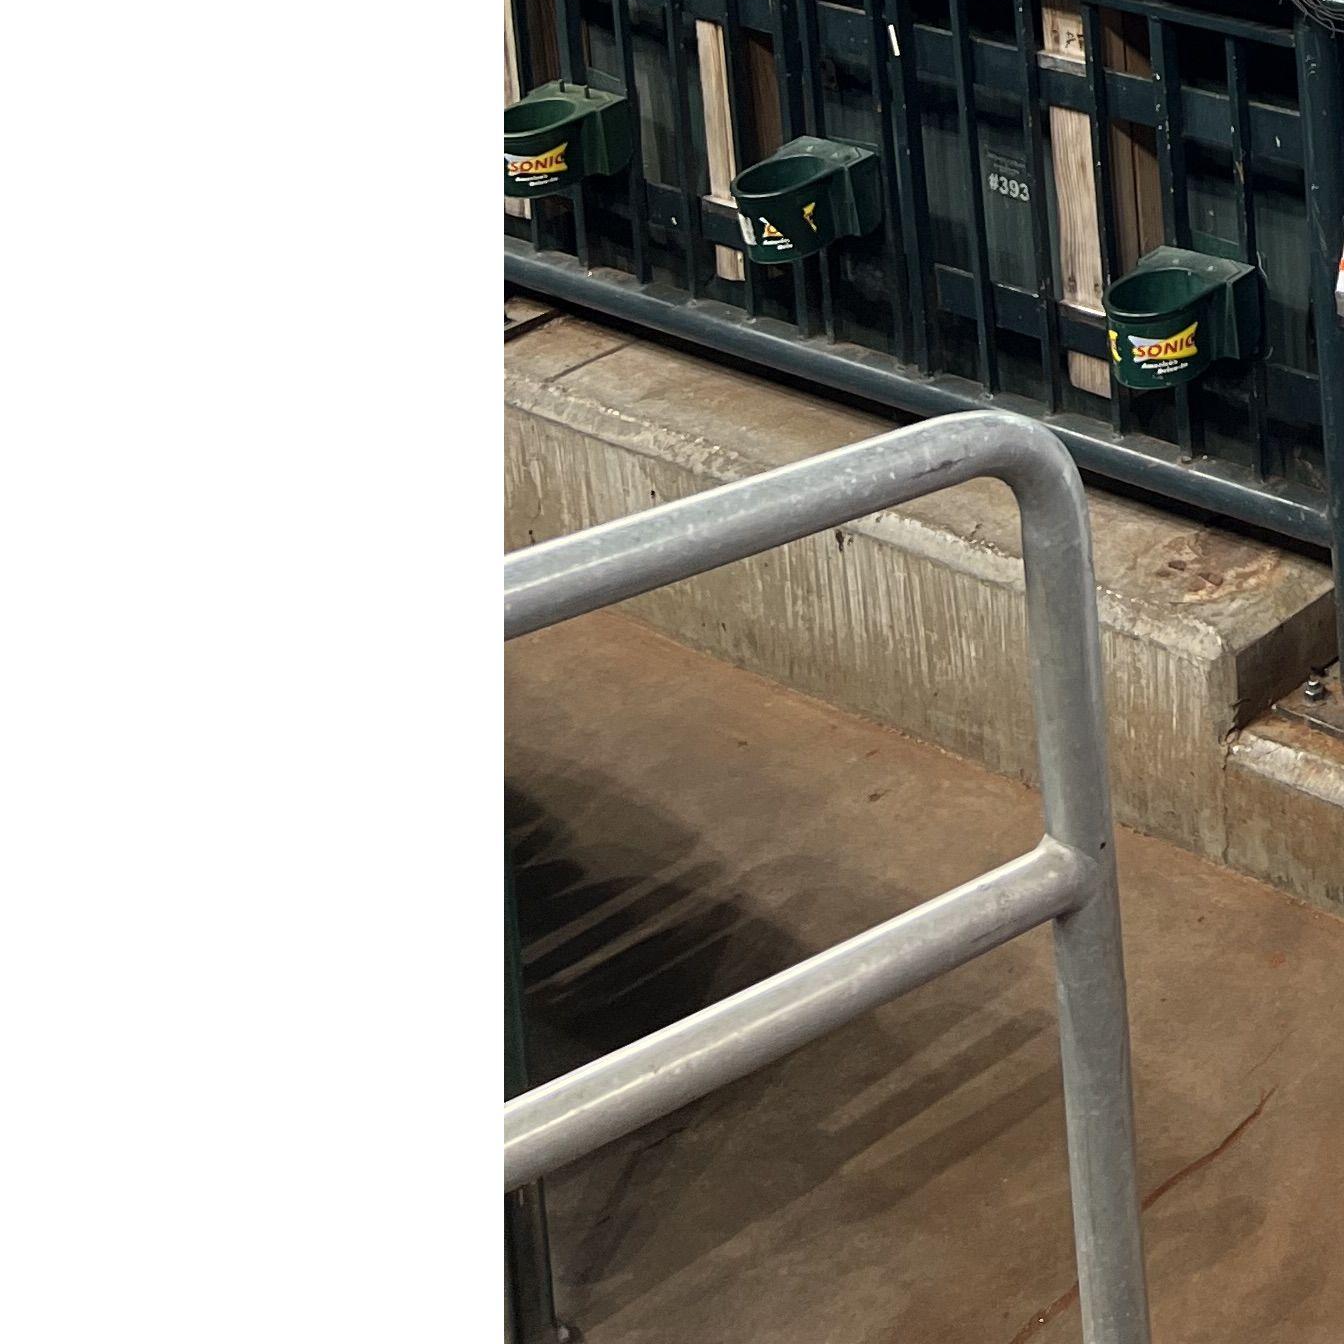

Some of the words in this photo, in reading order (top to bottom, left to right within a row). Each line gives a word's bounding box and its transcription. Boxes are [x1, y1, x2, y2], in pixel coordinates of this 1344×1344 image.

[510, 154, 566, 173] SONIC
[988, 172, 1031, 202] #393
[1136, 332, 1196, 358] SONIC
